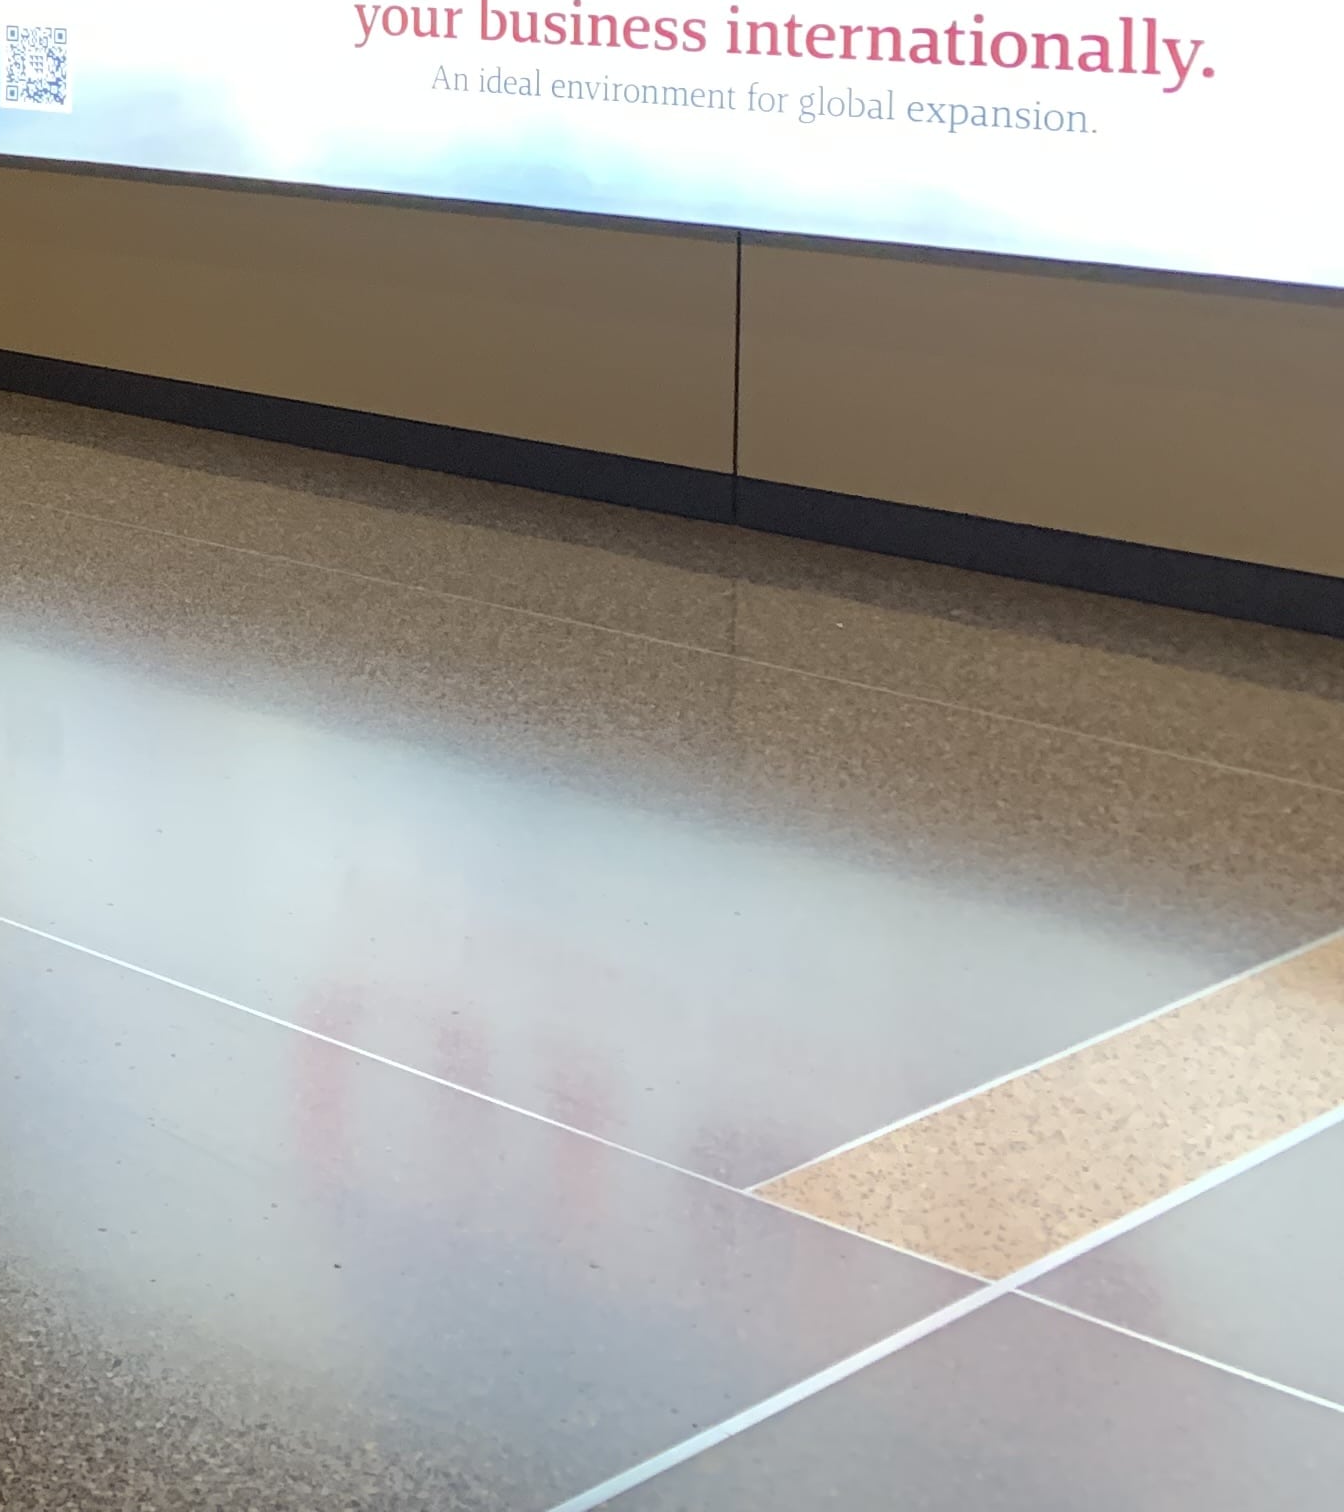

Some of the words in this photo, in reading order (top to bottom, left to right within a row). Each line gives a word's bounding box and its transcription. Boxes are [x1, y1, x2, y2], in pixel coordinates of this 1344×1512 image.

[353, 2, 463, 48] your
[726, 5, 1215, 94] internationally.
[431, 65, 469, 92] An
[479, 67, 542, 97] ideal
[551, 75, 737, 110] environment
[747, 82, 789, 113] for
[799, 86, 895, 123] global
[907, 100, 1098, 134] expansion.
